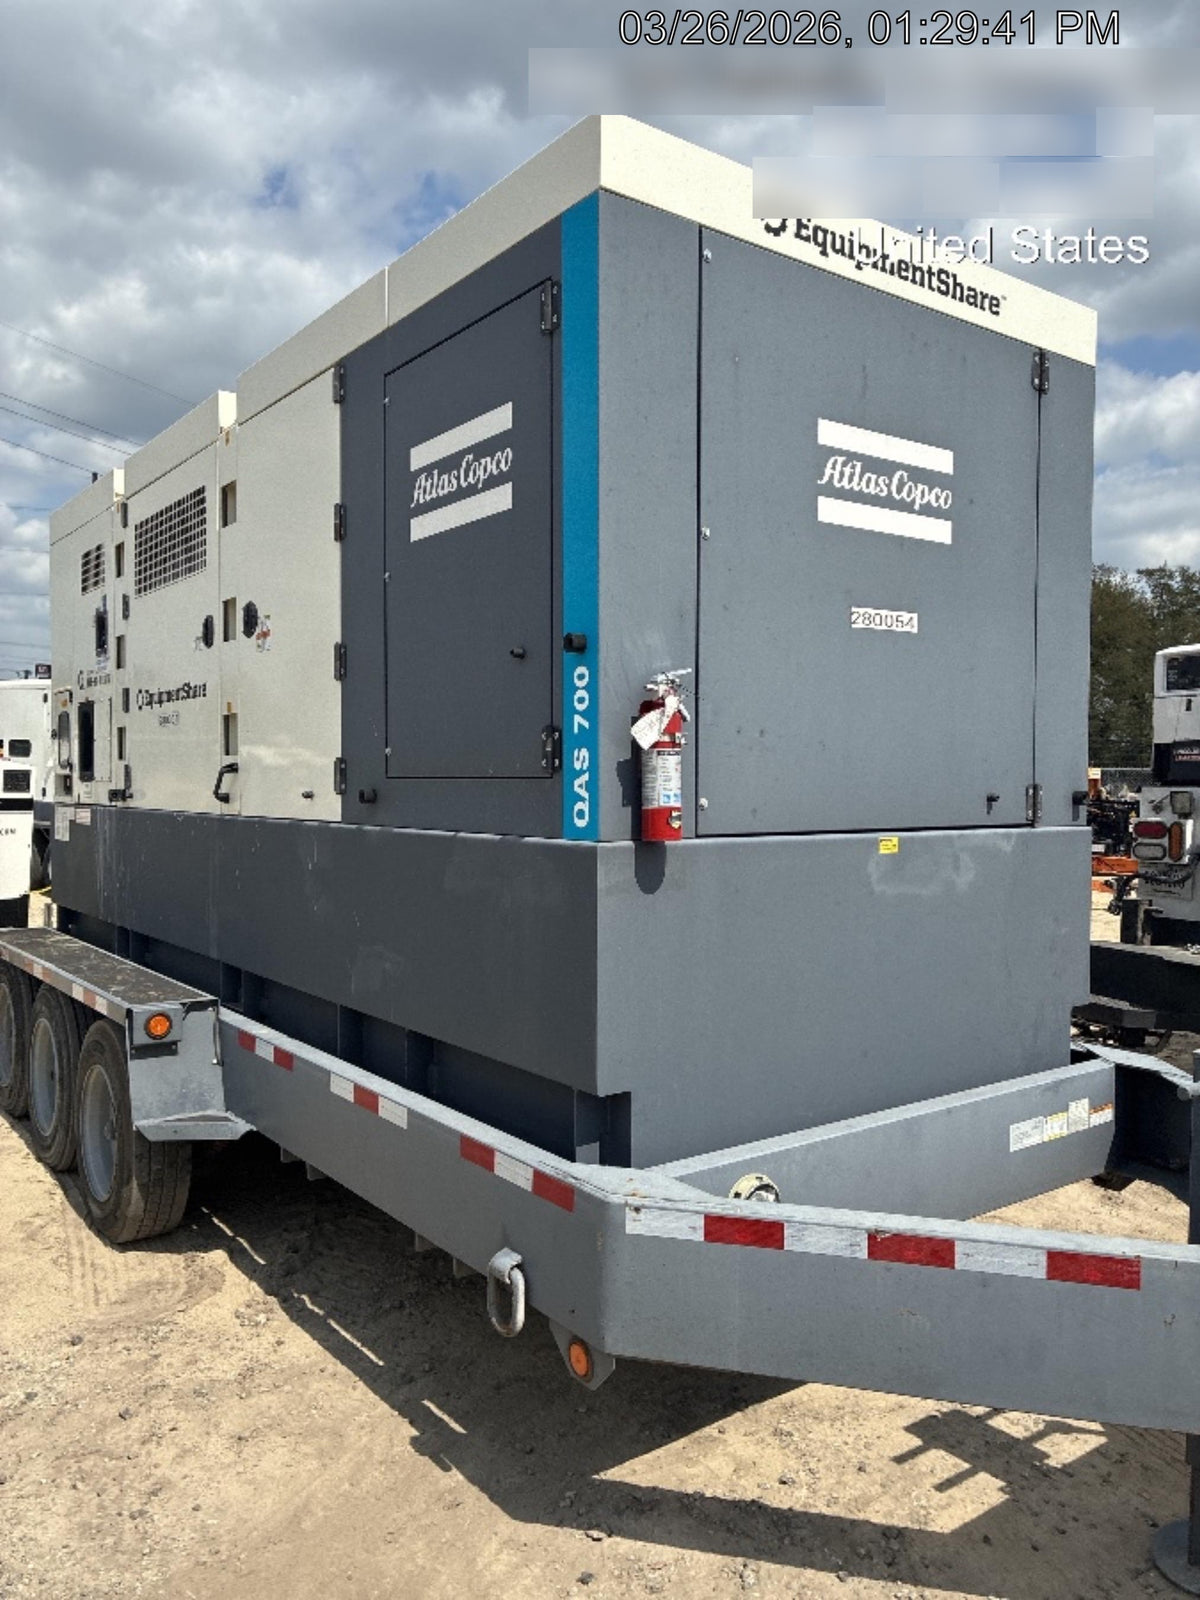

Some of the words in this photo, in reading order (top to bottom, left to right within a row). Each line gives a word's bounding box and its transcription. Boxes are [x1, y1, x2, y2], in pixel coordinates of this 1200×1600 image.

[410, 469, 458, 509] Atlas
[460, 447, 512, 489] Copco
[817, 455, 889, 497] Atlas
[890, 470, 953, 511] Copco
[850, 611, 916, 630] 280054
[573, 665, 590, 734] 700
[573, 747, 590, 828] QAS
